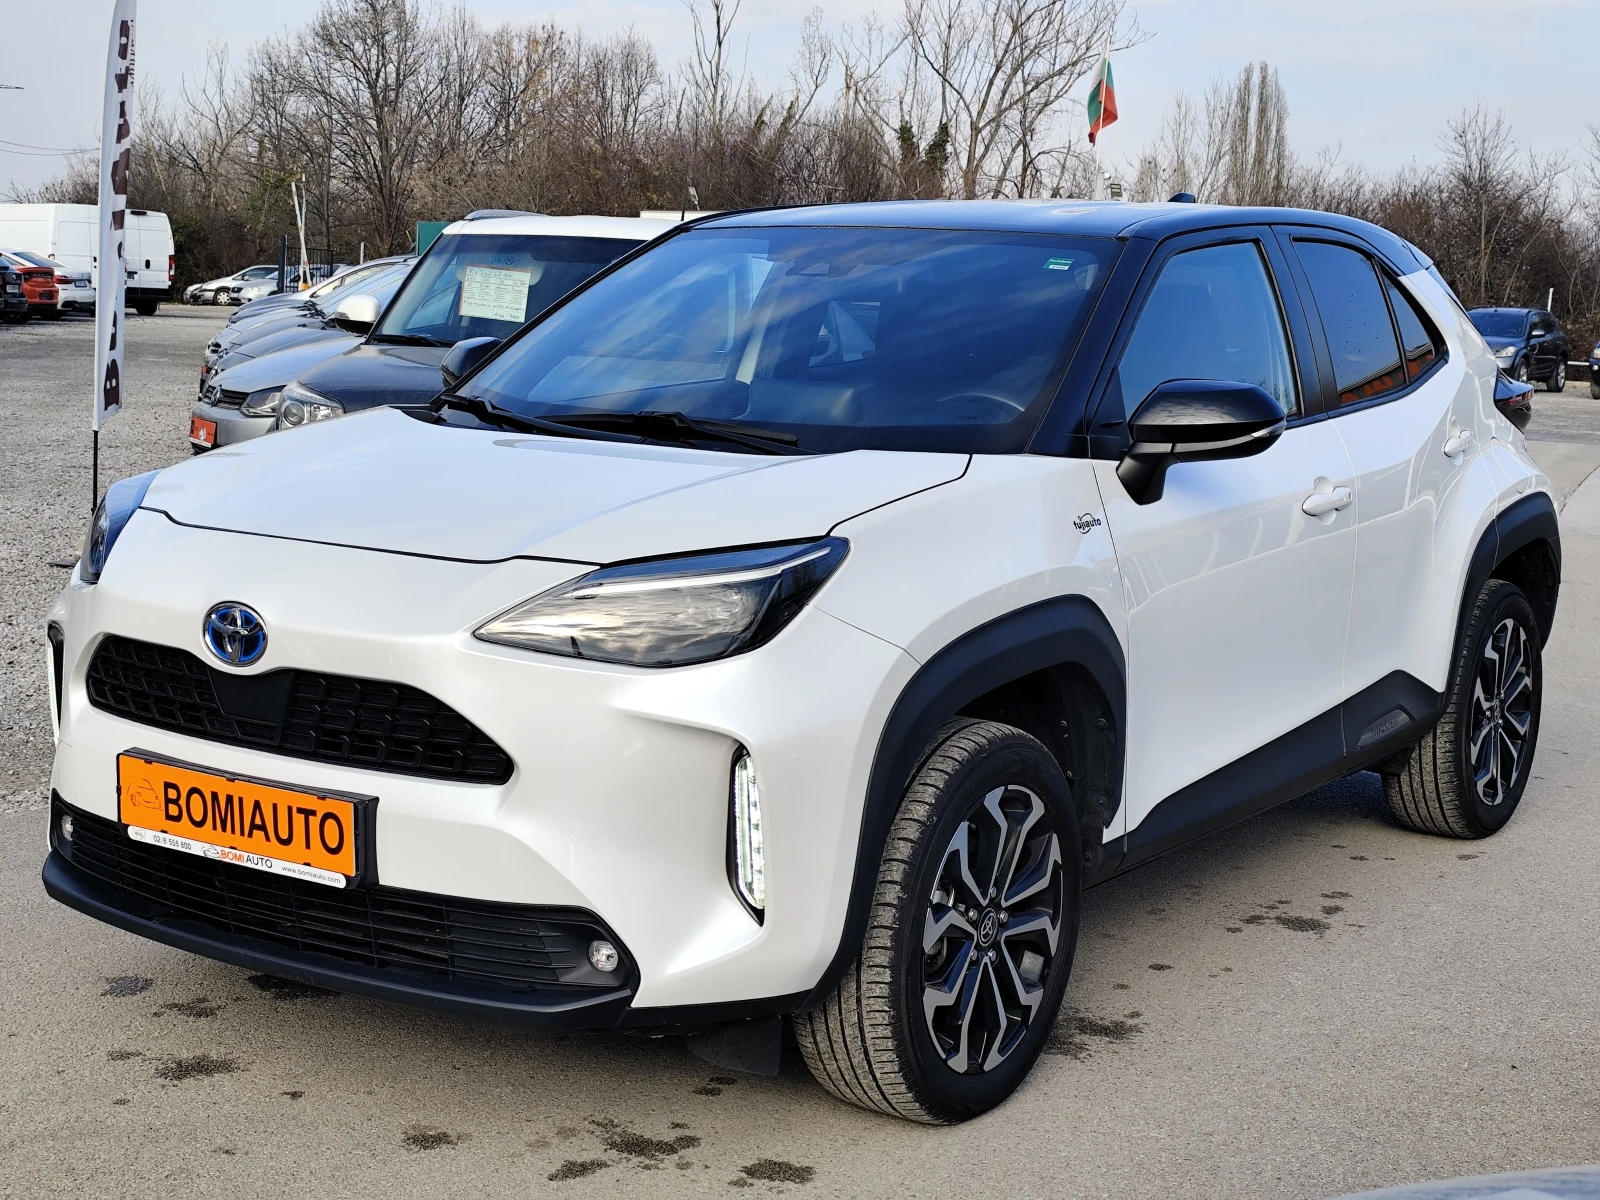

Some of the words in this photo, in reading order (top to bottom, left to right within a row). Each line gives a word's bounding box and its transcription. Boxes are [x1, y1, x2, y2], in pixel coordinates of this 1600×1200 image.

[163, 780, 345, 855] BOMIAUTO
[168, 838, 180, 848] 555
[220, 849, 245, 864] BOMI
[245, 854, 273, 869] AUTO
[281, 866, 341, 884] www.bomiauto.com
